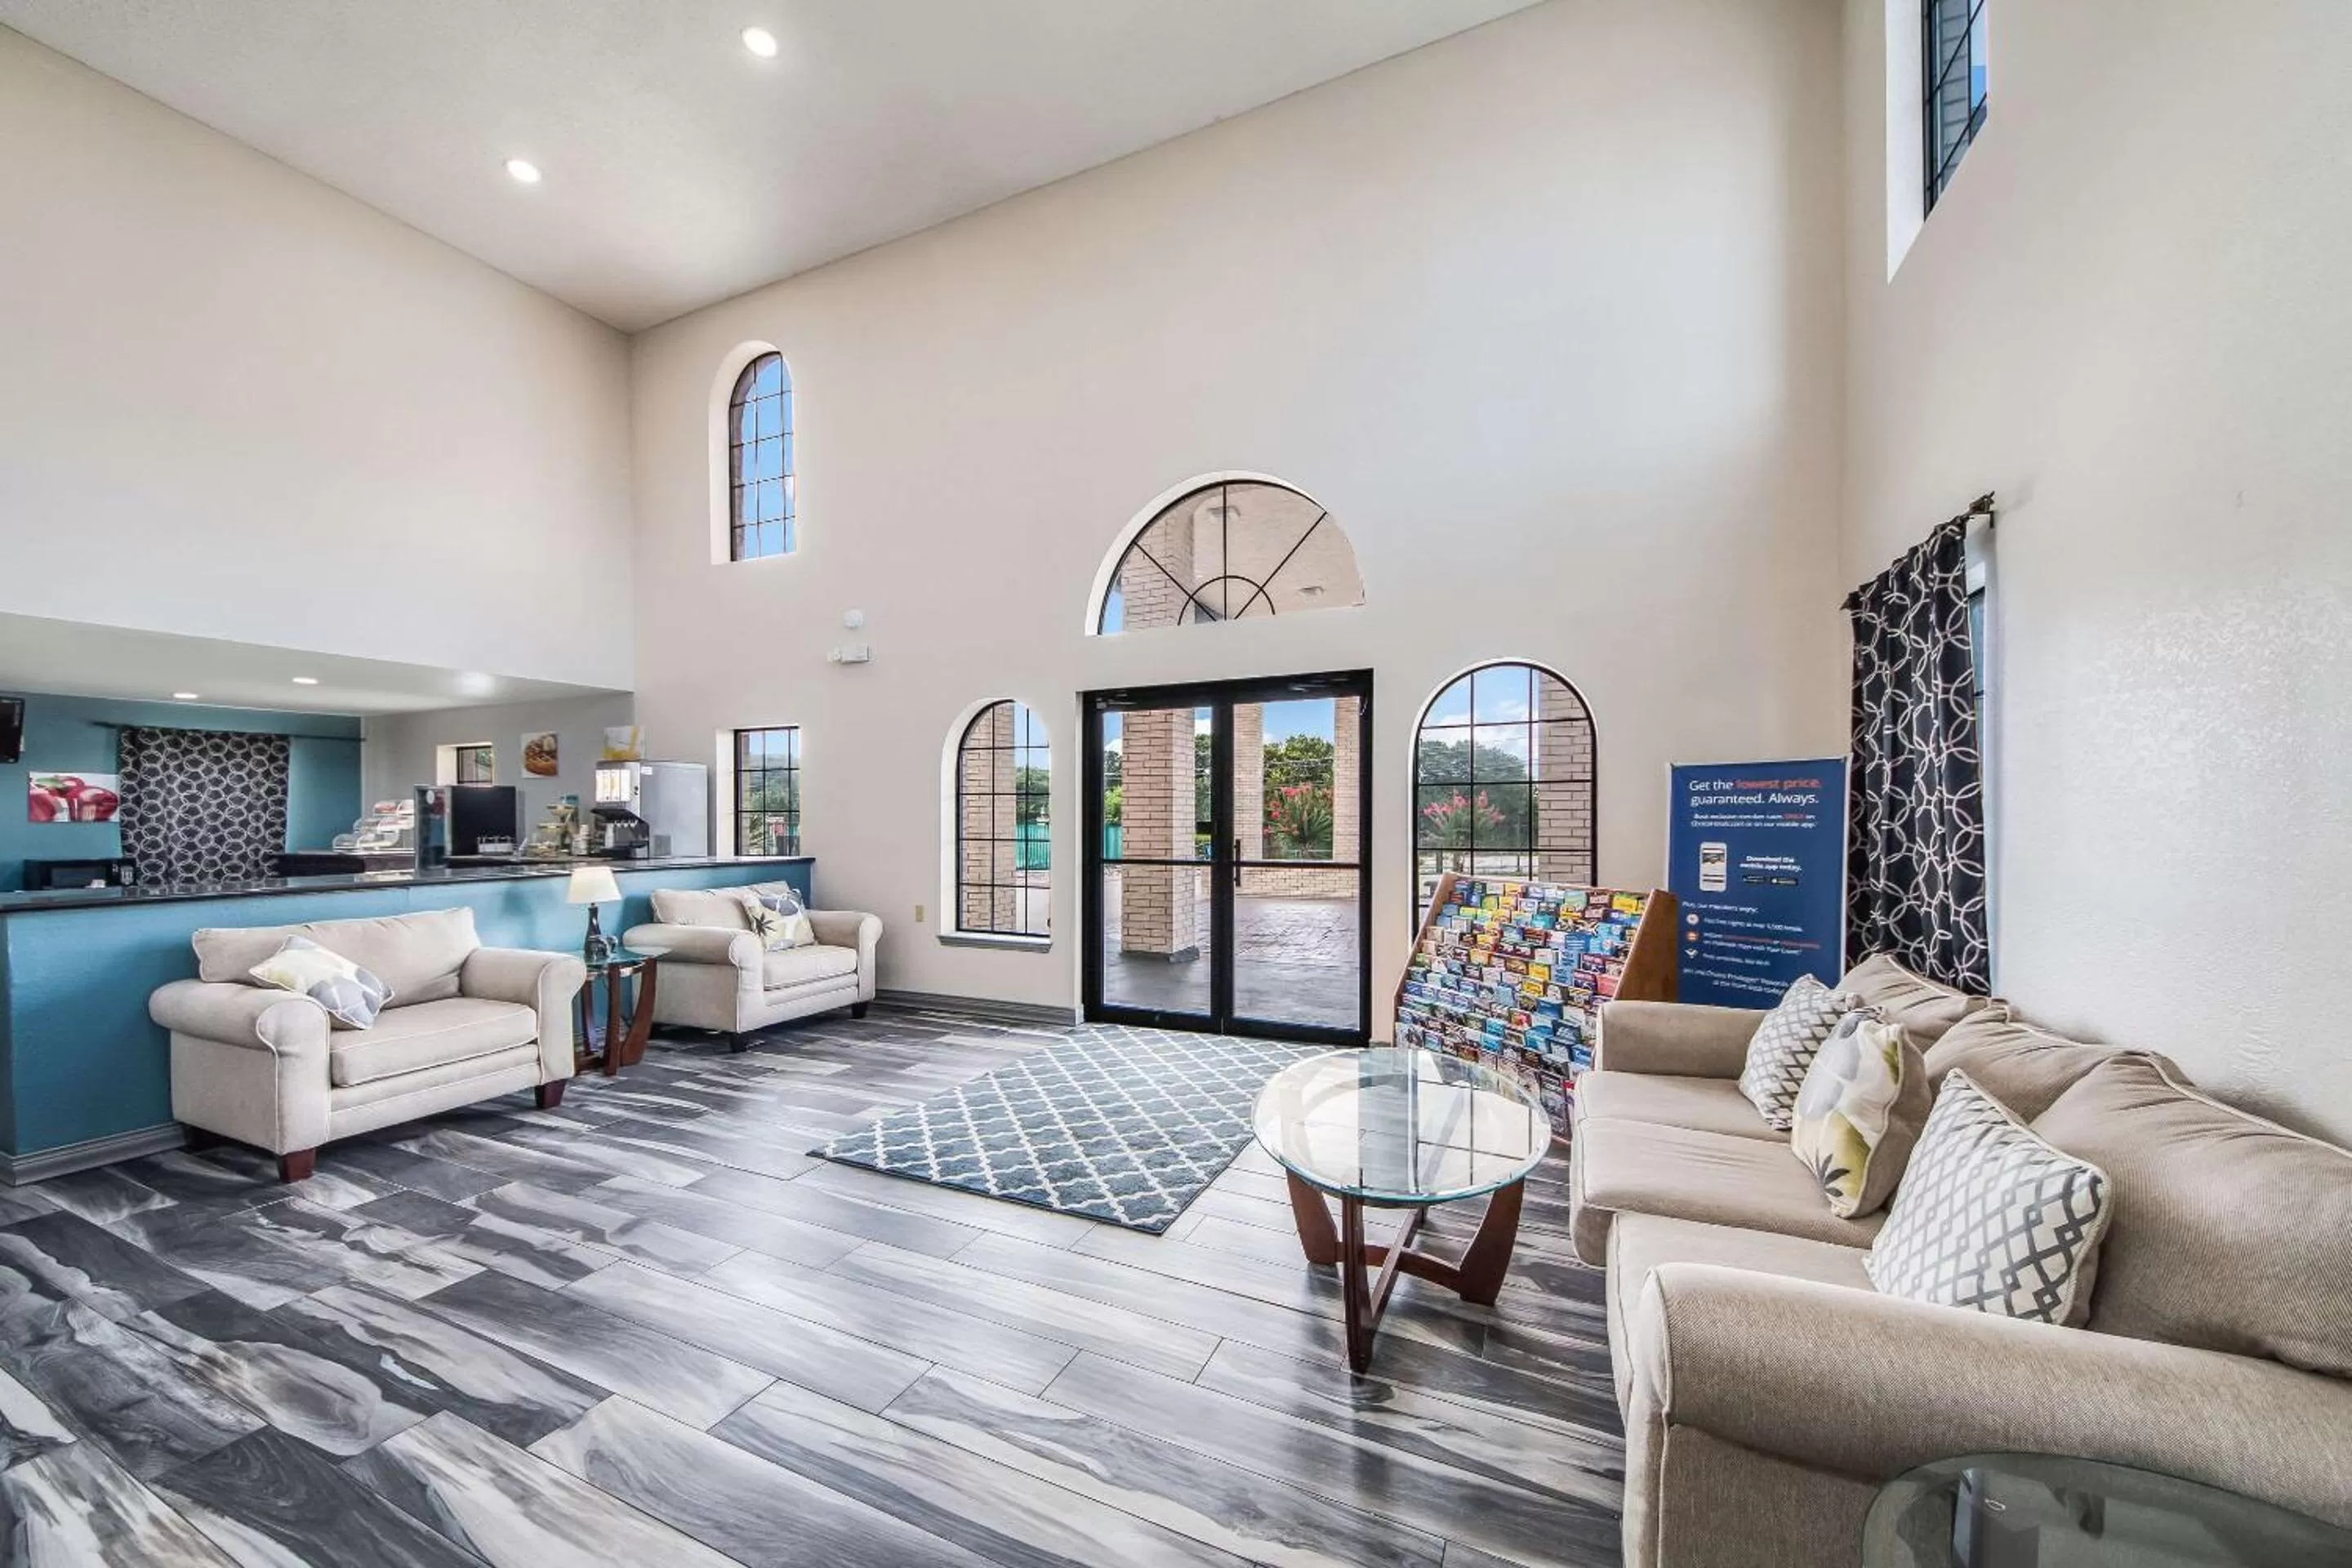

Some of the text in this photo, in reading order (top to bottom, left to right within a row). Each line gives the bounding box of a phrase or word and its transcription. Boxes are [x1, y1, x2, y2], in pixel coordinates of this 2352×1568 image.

[1689, 779, 1710, 791] Get
[1713, 779, 1733, 791] the
[1690, 792, 1819, 808] guaranteed. Always.
